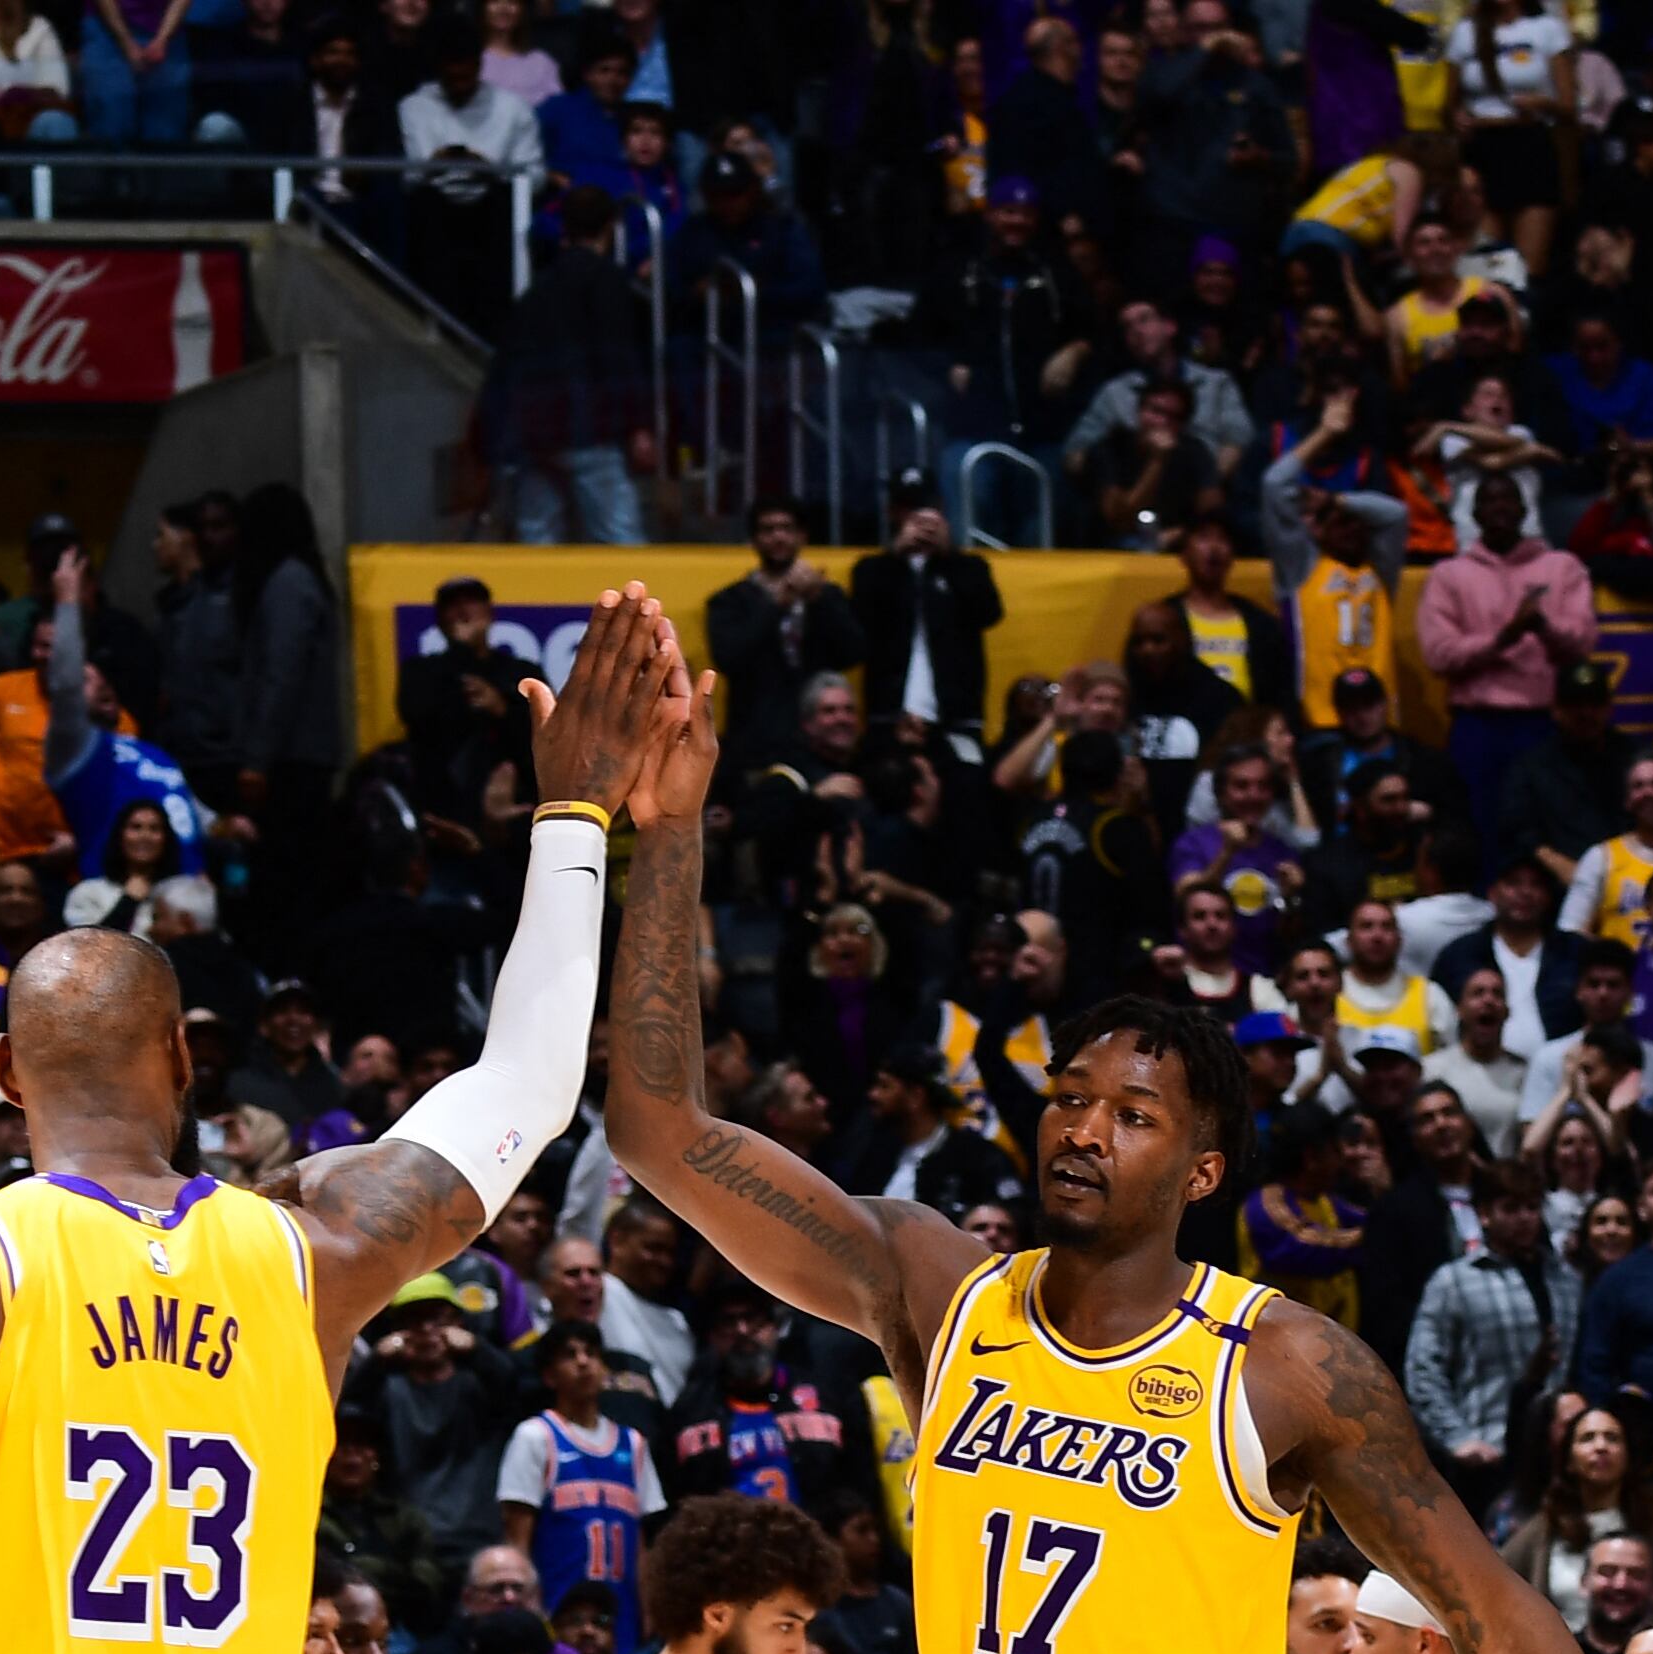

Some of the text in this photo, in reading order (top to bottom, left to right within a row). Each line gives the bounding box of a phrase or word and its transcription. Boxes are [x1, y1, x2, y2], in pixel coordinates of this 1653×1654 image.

[84, 1294, 241, 1381] JAMES
[1135, 1376, 1199, 1405] bibigo
[934, 1376, 1190, 1509] LAKERS
[66, 1423, 256, 1650] 23
